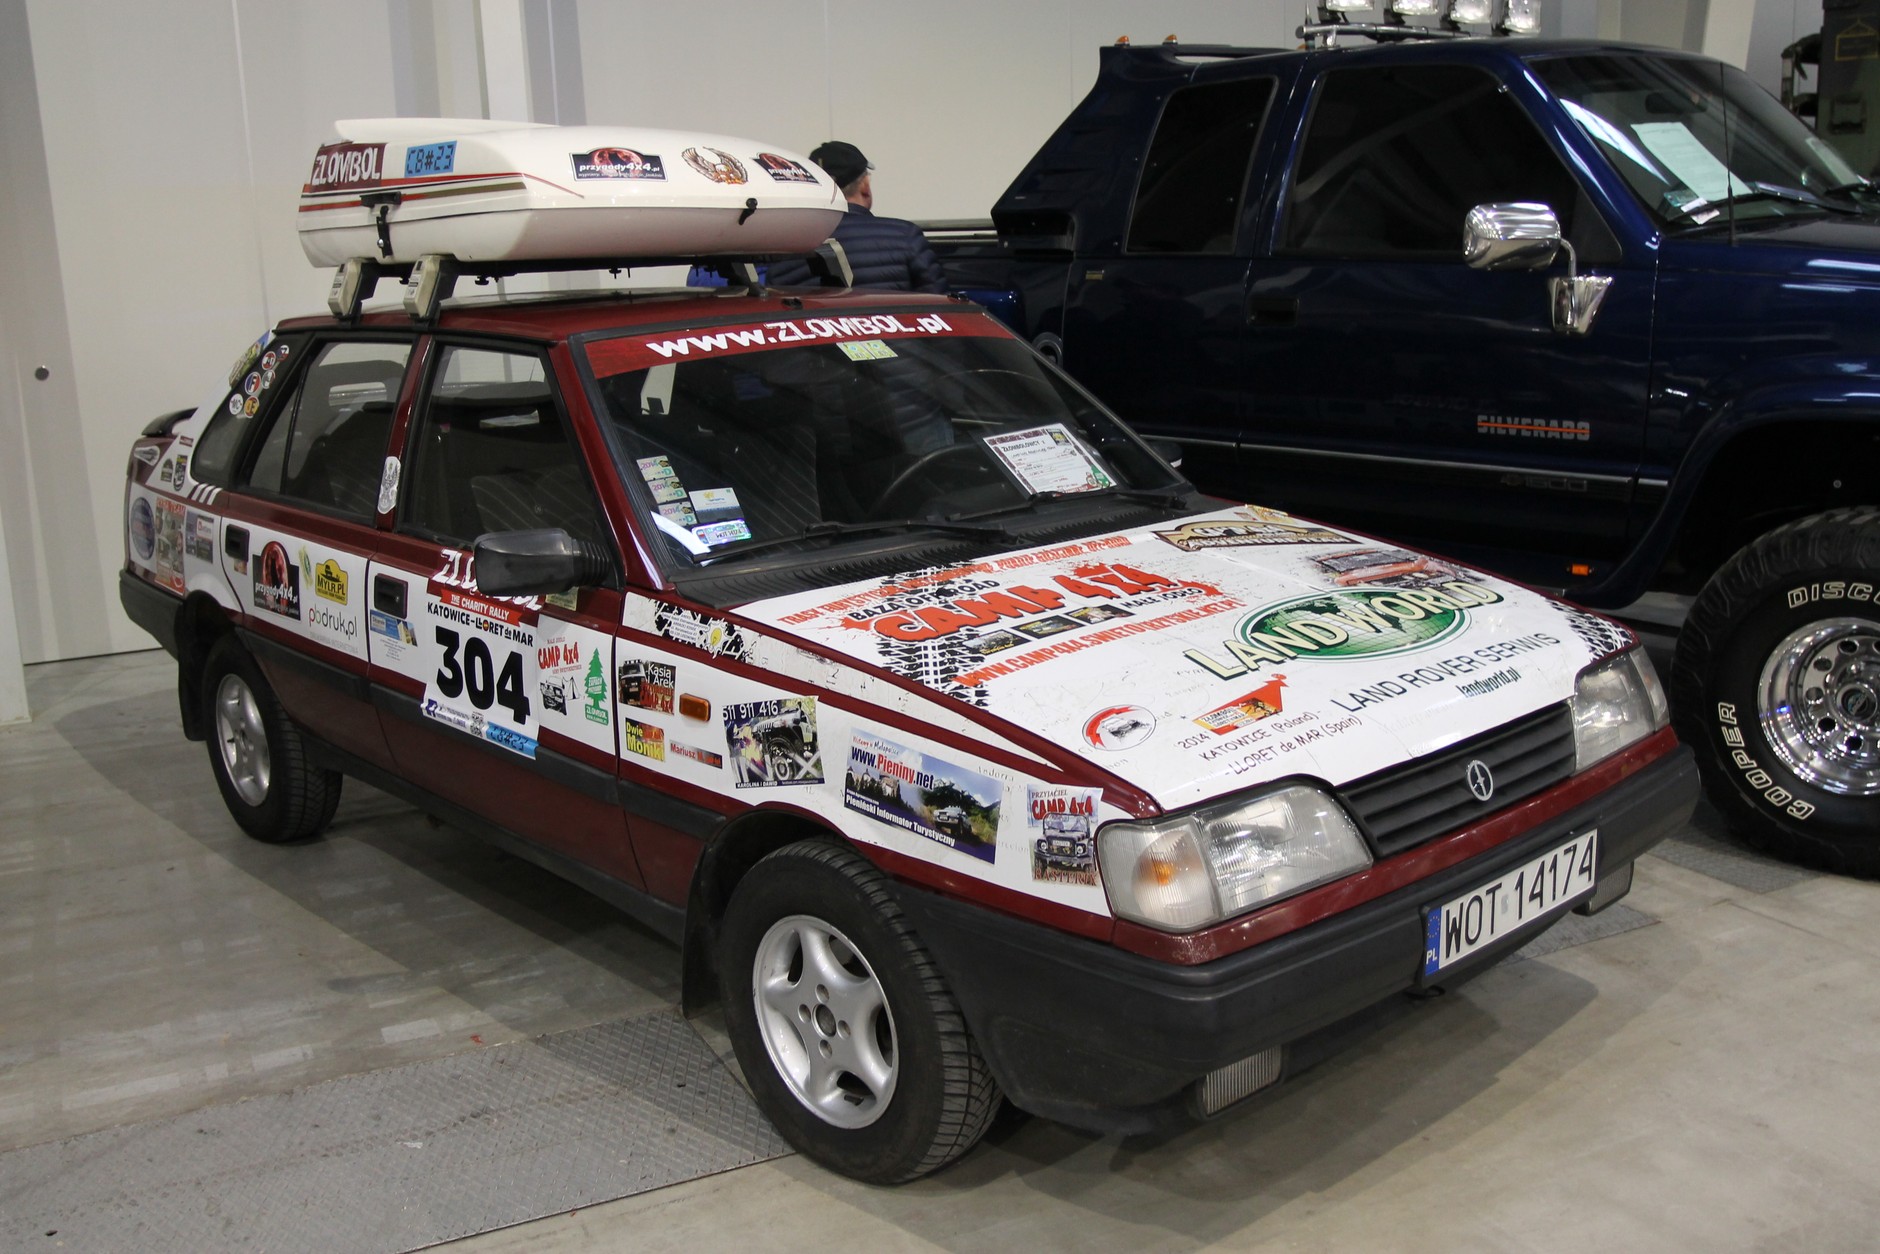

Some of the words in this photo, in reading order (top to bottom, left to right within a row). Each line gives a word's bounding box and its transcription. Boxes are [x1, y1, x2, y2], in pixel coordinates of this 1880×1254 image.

[406, 144, 455, 174] CB#23
[1476, 414, 1591, 441] SILVERADO
[317, 574, 346, 596] MYLR.PL
[451, 594, 460, 605] THE
[461, 597, 489, 617] CHARITY
[489, 607, 510, 620] RALLY
[848, 599, 903, 622] BAZA
[874, 582, 1065, 643] CAMP
[513, 629, 533, 647] MAR
[1182, 581, 1505, 680] LANDWORLD
[538, 645, 560, 670] CAMP
[563, 641, 579, 665] 4x4
[435, 625, 531, 725] 304
[648, 663, 671, 679] Kasia
[653, 674, 674, 689] Arek
[1330, 680, 1407, 712] LAND
[1398, 655, 1482, 689] ROVER
[1475, 632, 1561, 662] SERWIS
[1456, 666, 1521, 699] landworld.pl
[739, 703, 755, 719] 911
[759, 700, 779, 716] 416
[626, 722, 643, 737] Dwie
[1199, 731, 1272, 761] KATOWICE
[1272, 711, 1318, 734] (Poland)
[627, 734, 664, 762] Moniki
[670, 743, 696, 759] Mariusz
[1229, 746, 1279, 776] LLORET
[1280, 740, 1297, 755] de
[1297, 731, 1325, 747] MAR
[1325, 715, 1363, 738] (Spain)
[851, 745, 935, 791] www.Pieniny.net
[1718, 702, 1816, 820] COOPER
[1032, 798, 1065, 820] CAMP
[1070, 796, 1093, 816] 4x4
[876, 806, 913, 830] Informator
[913, 821, 956, 848] Turystyczny
[1445, 883, 1503, 959] WOT
[1514, 835, 1594, 921] 14174
[1426, 950, 1438, 965] PL
